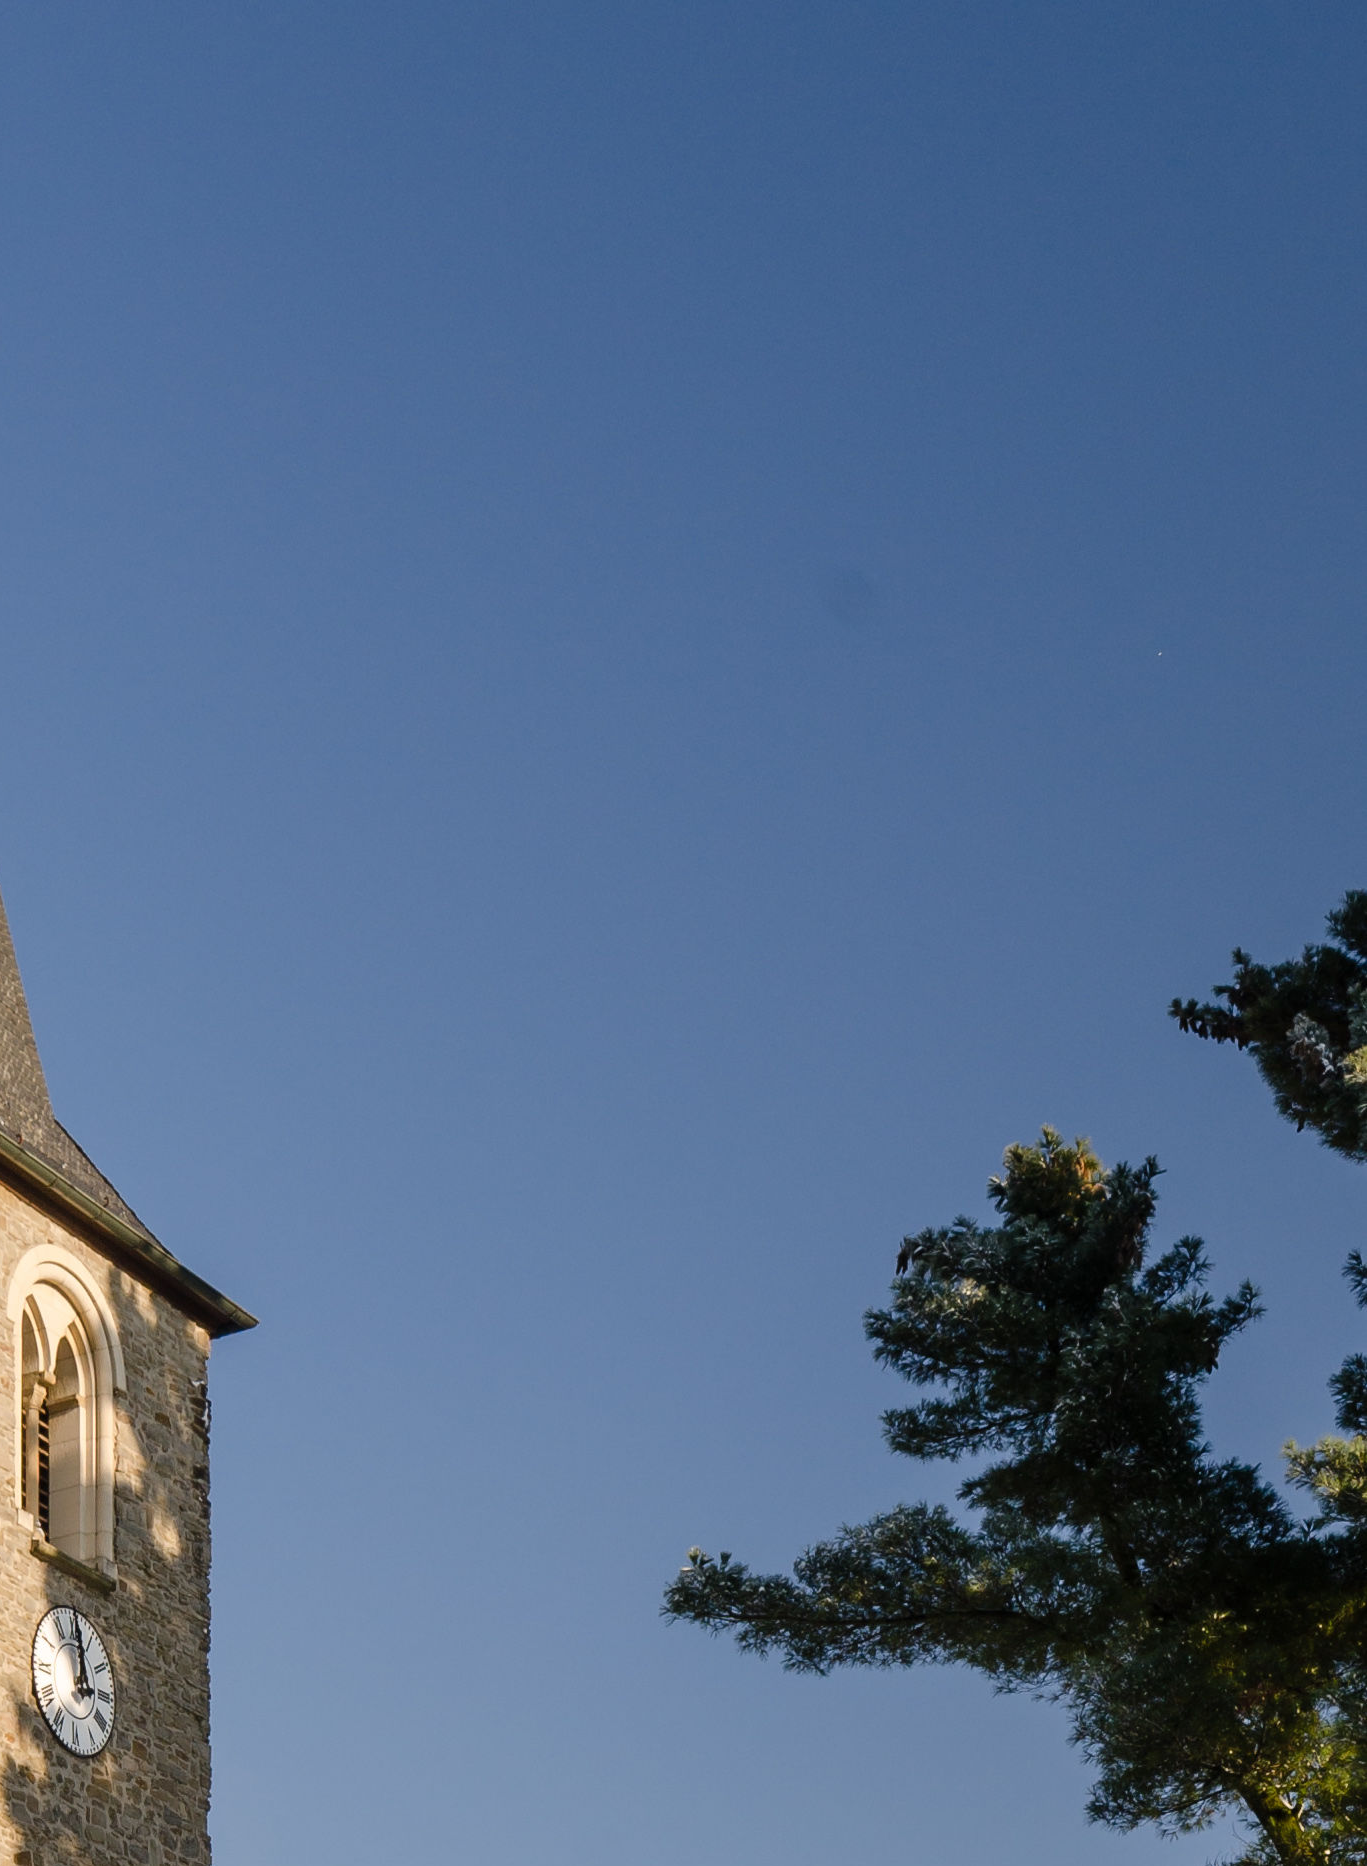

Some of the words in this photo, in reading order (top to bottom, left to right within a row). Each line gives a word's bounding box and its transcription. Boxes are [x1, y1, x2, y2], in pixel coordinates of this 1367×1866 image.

[86, 1636, 93, 1652] I
[94, 1662, 107, 1674] II
[41, 1684, 54, 1707] VIII
[97, 1688, 110, 1704] III
[53, 1706, 65, 1733] VII
[71, 1720, 80, 1746] VI
[87, 1726, 96, 1746] V
